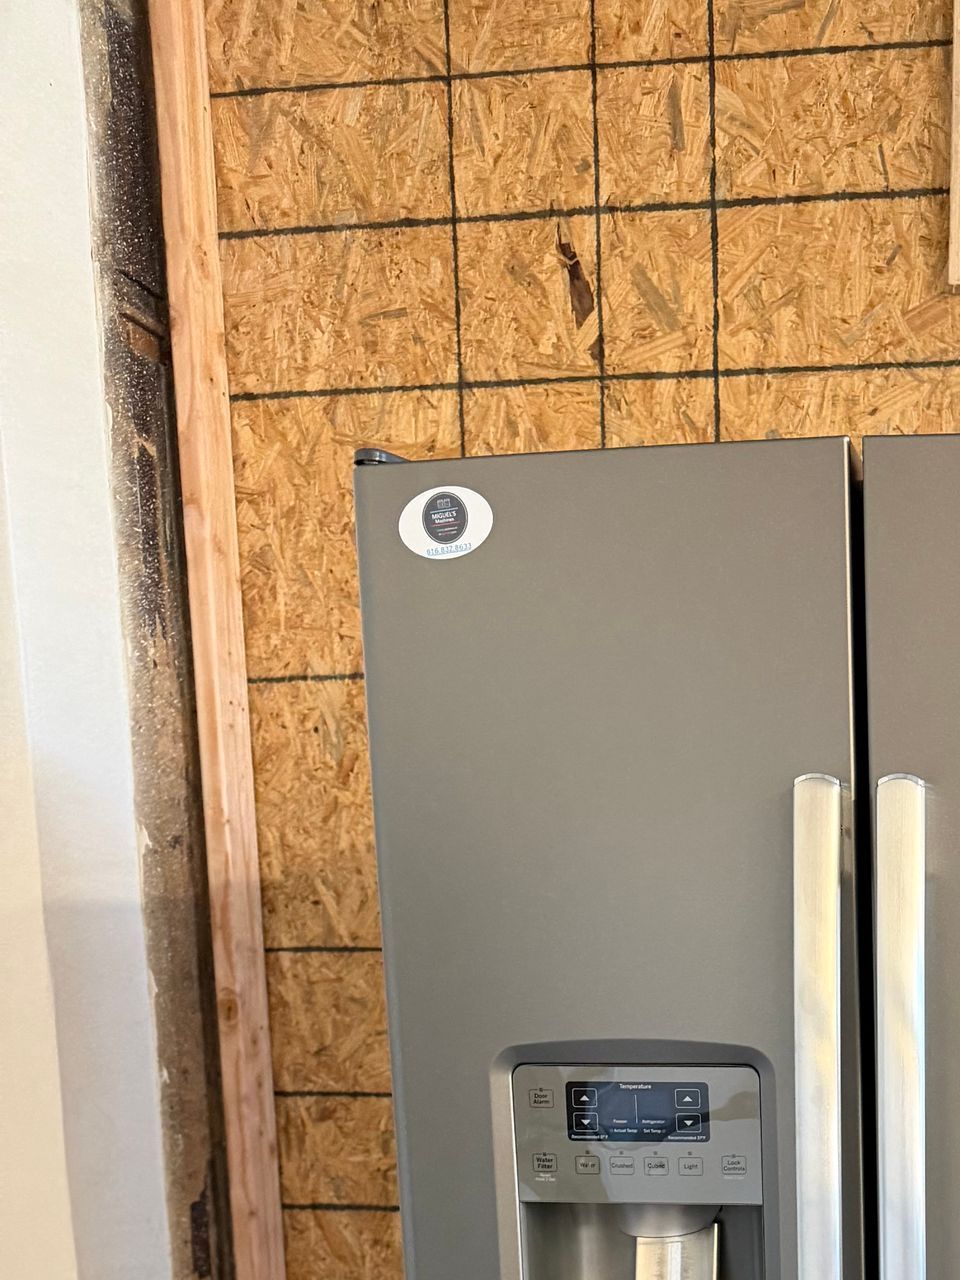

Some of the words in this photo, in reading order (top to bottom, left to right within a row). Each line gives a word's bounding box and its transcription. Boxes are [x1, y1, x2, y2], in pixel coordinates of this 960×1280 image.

[431, 510, 457, 520] MIGUEL'S
[619, 1083, 652, 1091] Temperature
[683, 1162, 698, 1171] Light
